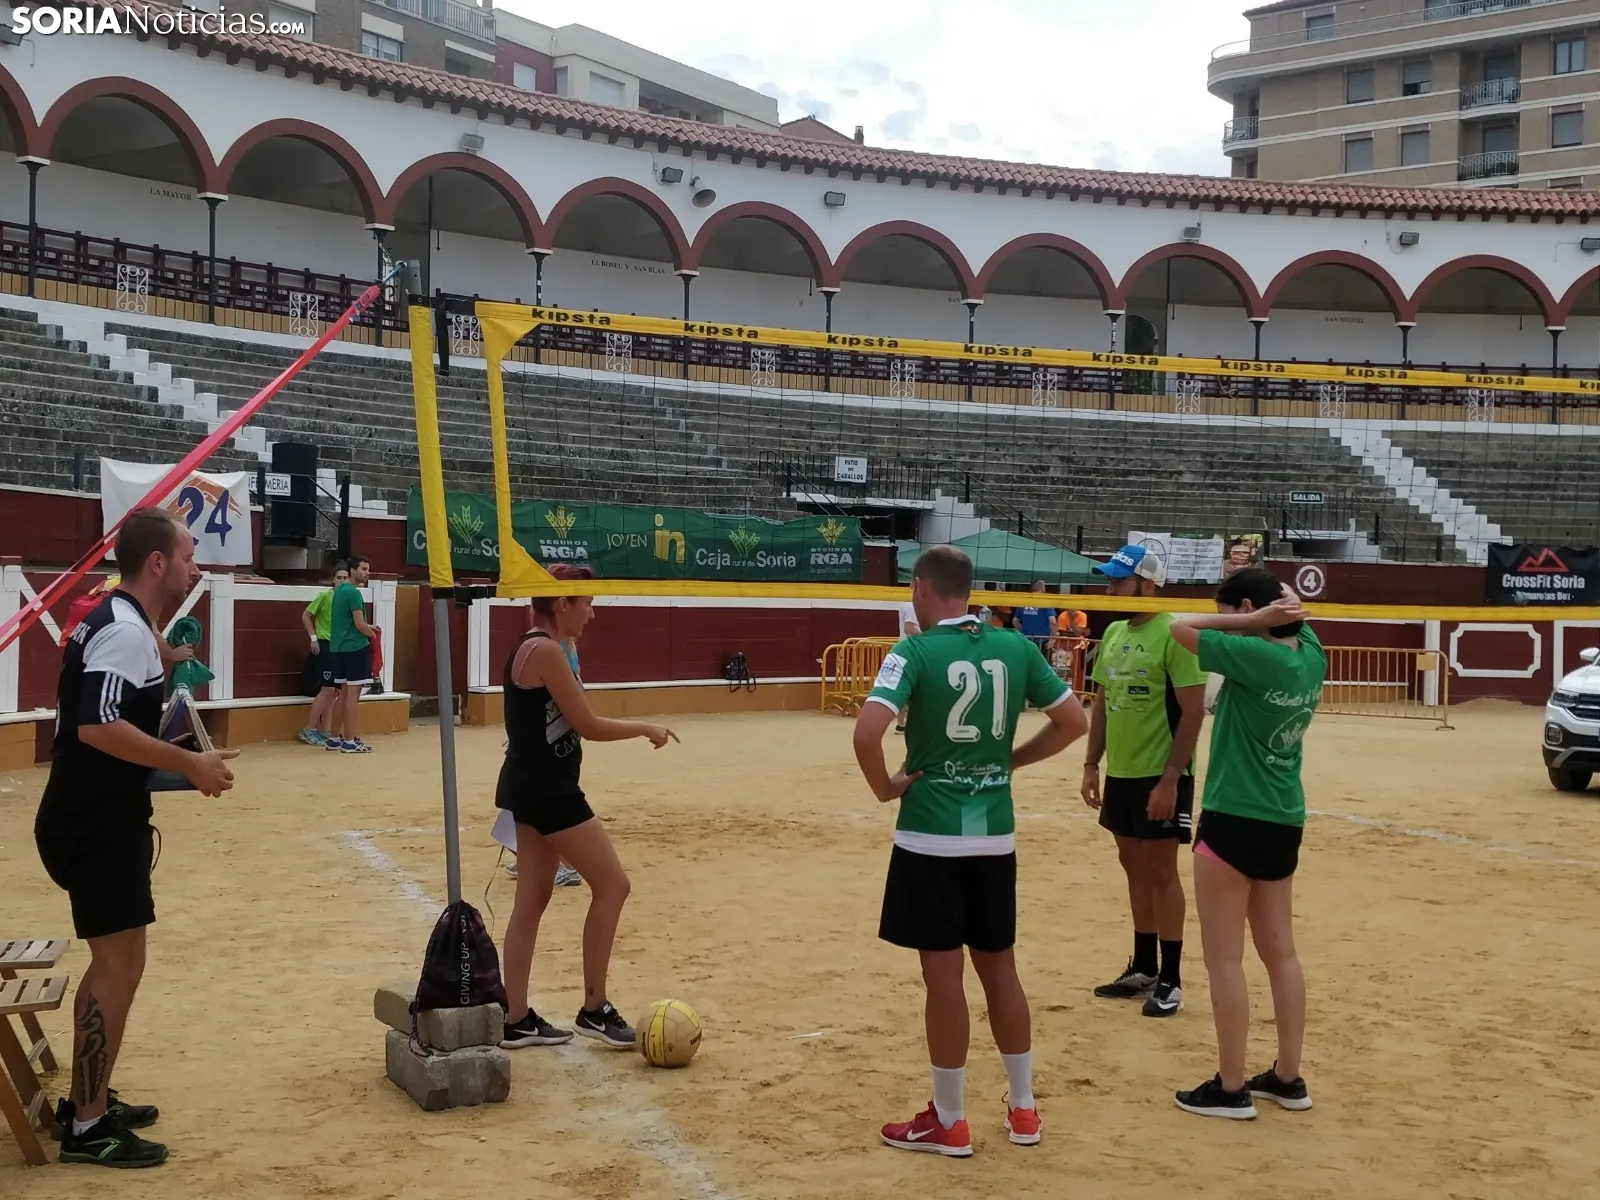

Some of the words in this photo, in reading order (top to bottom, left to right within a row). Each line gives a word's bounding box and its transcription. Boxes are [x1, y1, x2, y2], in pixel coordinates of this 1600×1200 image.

[150, 187, 161, 196] LA
[162, 189, 192, 201] MAYOR
[634, 264, 647, 273] SAN
[531, 307, 611, 326] kipsta
[684, 322, 759, 340] kipsta
[827, 334, 899, 349] kipsta
[963, 343, 1033, 358] kipsta
[1091, 351, 1159, 366] kipsta
[1220, 359, 1286, 373] kipsta
[1345, 366, 1408, 380] kipsta
[1465, 373, 1525, 387] kipsta
[837, 472, 864, 481] CABALLOS
[1292, 492, 1321, 502] SALIDA
[606, 533, 648, 549] JOVEN
[653, 513, 686, 563] in
[540, 545, 589, 560] RGA
[695, 547, 731, 570] Caja
[756, 550, 797, 568] Soria
[810, 553, 853, 565] RGA
[1304, 571, 1318, 591] 4
[1502, 573, 1552, 588] CrossFit
[1553, 574, 1586, 589] Soria
[946, 658, 1009, 743] 21
[461, 942, 470, 959] UP
[460, 963, 471, 1005] GIVING
